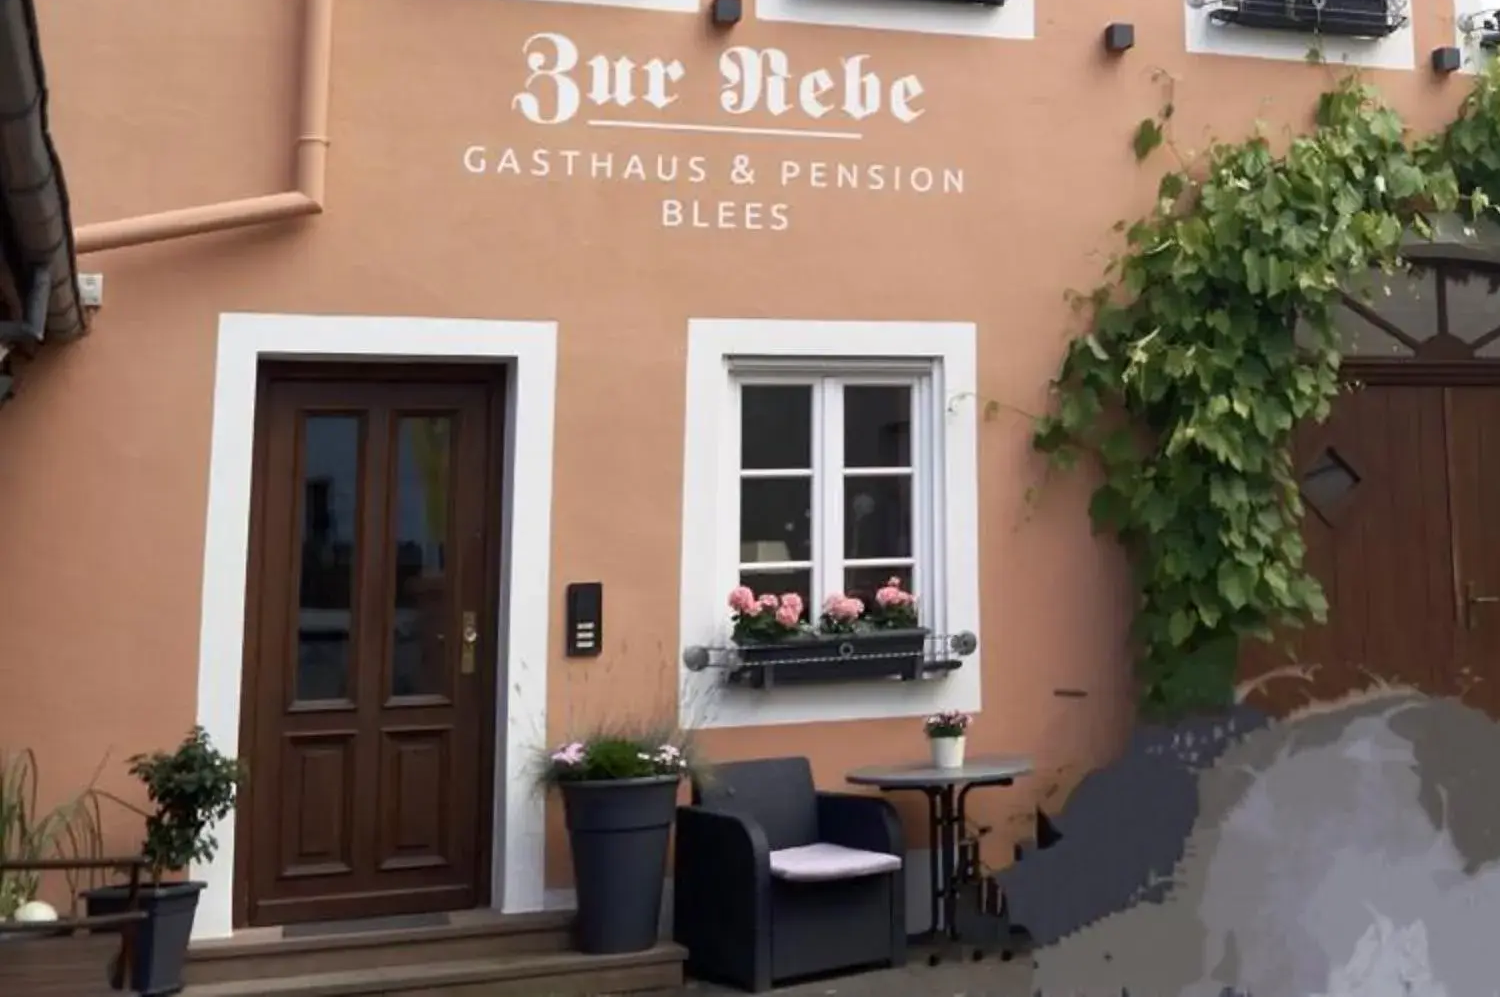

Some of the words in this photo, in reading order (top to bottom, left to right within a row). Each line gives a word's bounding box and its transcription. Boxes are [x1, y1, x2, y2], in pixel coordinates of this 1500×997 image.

[511, 32, 685, 124] Zur
[718, 46, 925, 123] Rebe
[463, 146, 706, 183] GASTHAUS
[730, 154, 755, 184] &
[781, 160, 964, 193] PENSION
[661, 199, 789, 231] BLEES
